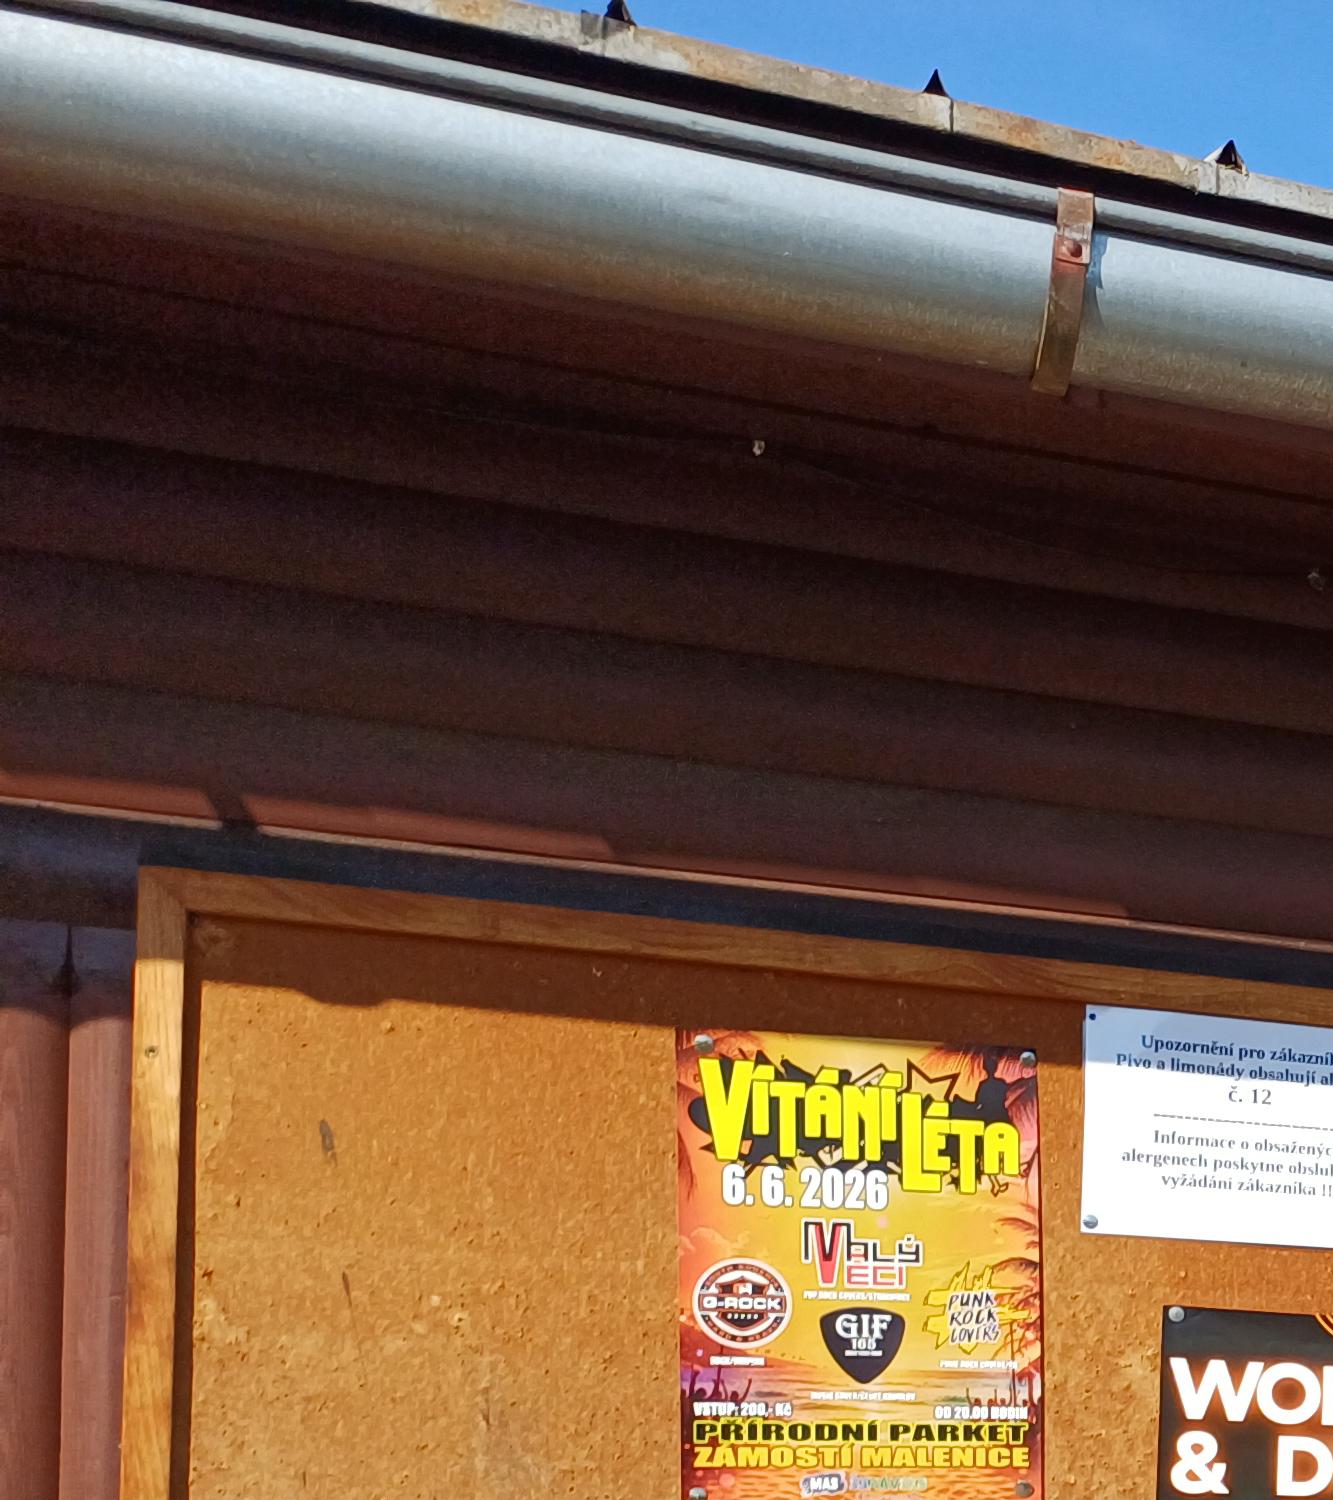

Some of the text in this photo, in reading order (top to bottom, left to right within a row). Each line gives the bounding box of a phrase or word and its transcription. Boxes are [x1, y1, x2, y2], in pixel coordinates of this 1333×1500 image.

[1140, 1034, 1234, 1058] Upozornění
[1238, 1046, 1266, 1061] pro
[1116, 1053, 1151, 1069] Pivo
[1156, 1059, 1165, 1070] a
[1170, 1057, 1245, 1080] limonády
[1249, 1065, 1316, 1087] obsahují
[1228, 1086, 1272, 1105] č. 12
[901, 1092, 1021, 1195] LÉTA
[1153, 1130, 1236, 1150] Informace
[1240, 1140, 1249, 1150] o
[1121, 1148, 1207, 1168] alergenech
[1213, 1156, 1284, 1174] poskytne
[721, 1164, 888, 1210] 6. 6. 2026
[1161, 1172, 1233, 1190] vyžádání
[1237, 1178, 1316, 1196] zákazníka
[948, 1291, 994, 1310] PUNK
[835, 1313, 893, 1339] GIF
[949, 1308, 997, 1326] ROCK
[934, 1405, 952, 1419] OD
[990, 1405, 1029, 1420] HODIN
[694, 1418, 1028, 1443] PŘÍRODNÍ PARKET
[693, 1443, 1030, 1468] ZÁMOSTÍ MALENICE
[1168, 1429, 1230, 1496] &
